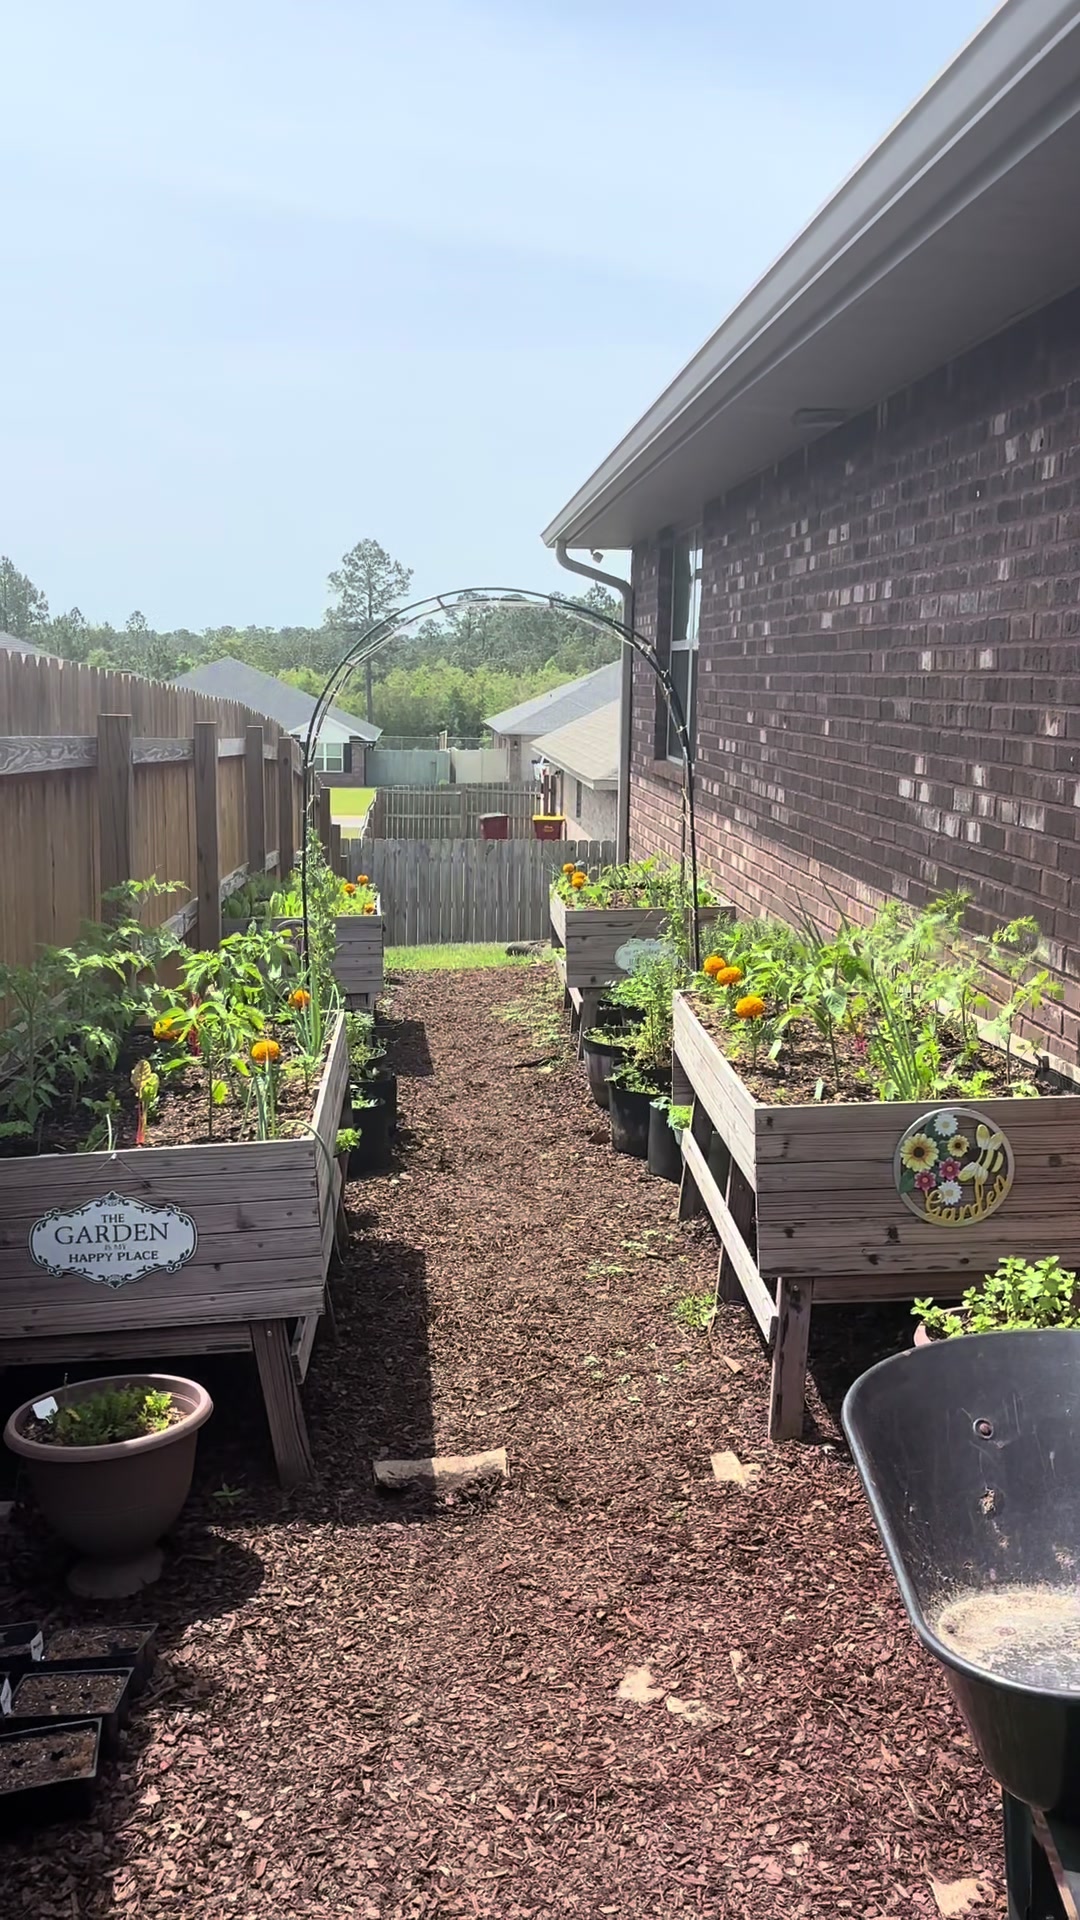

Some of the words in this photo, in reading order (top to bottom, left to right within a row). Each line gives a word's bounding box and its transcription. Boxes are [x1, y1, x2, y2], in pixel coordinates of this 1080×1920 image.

[925, 1176, 1008, 1222] Garden
[101, 1213, 125, 1223] THE
[54, 1222, 169, 1245] GARDEN
[69, 1252, 113, 1263] HAPPY
[117, 1250, 159, 1261] PLACE
